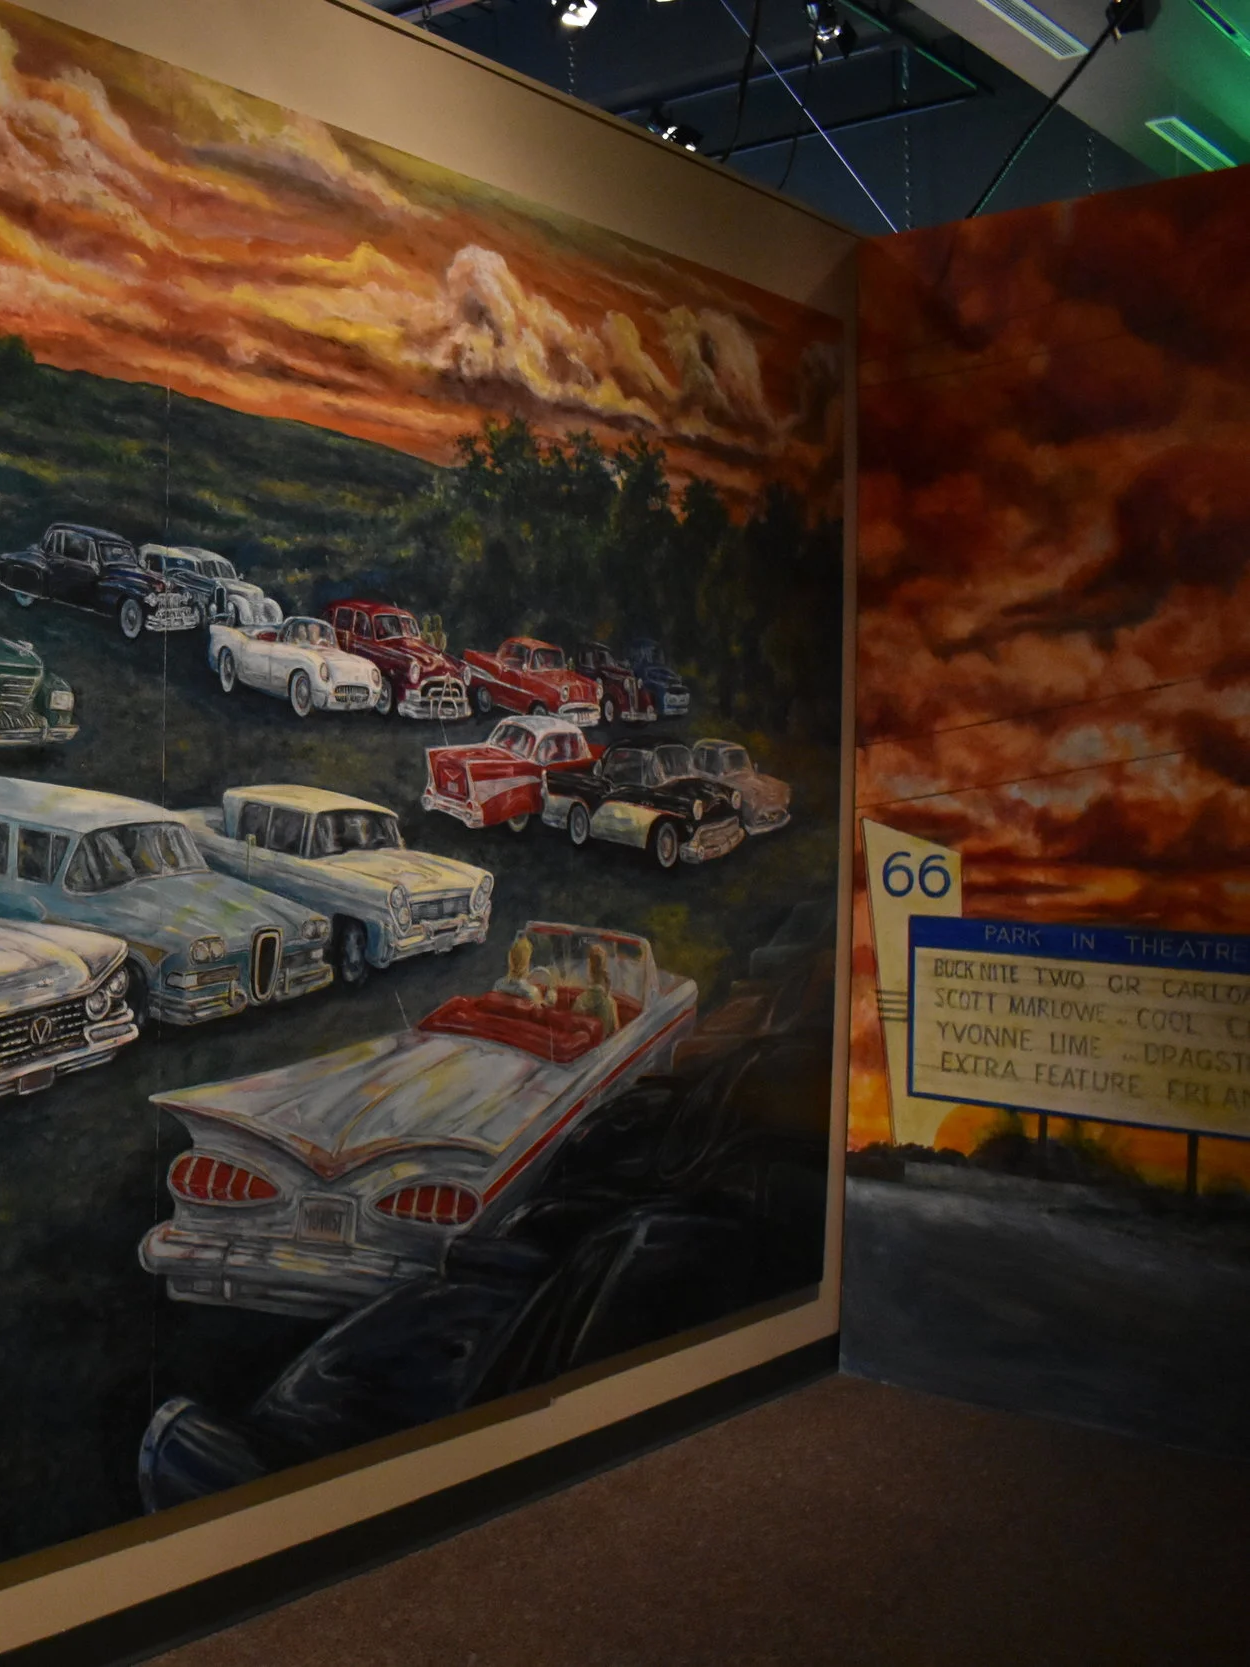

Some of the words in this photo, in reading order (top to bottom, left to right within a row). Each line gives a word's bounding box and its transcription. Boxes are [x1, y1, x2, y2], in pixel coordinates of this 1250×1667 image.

[882, 851, 951, 898] 66
[985, 924, 1041, 946] PARK
[1071, 932, 1095, 950] IN
[1125, 935, 1248, 962] THEATRE
[934, 958, 975, 980] BUCK
[980, 960, 1019, 984] NITE
[1035, 968, 1085, 991] TWO
[935, 988, 995, 1013] SCOTT
[1009, 996, 1108, 1024] MARLOWE
[1137, 1006, 1202, 1036] COOL
[936, 1021, 1032, 1052] YVONNE
[1050, 1032, 1101, 1060] LIME
[1144, 1042, 1250, 1075] DRAGST
[941, 1051, 1019, 1082] EXTRA
[1035, 1063, 1142, 1099] FEATURE
